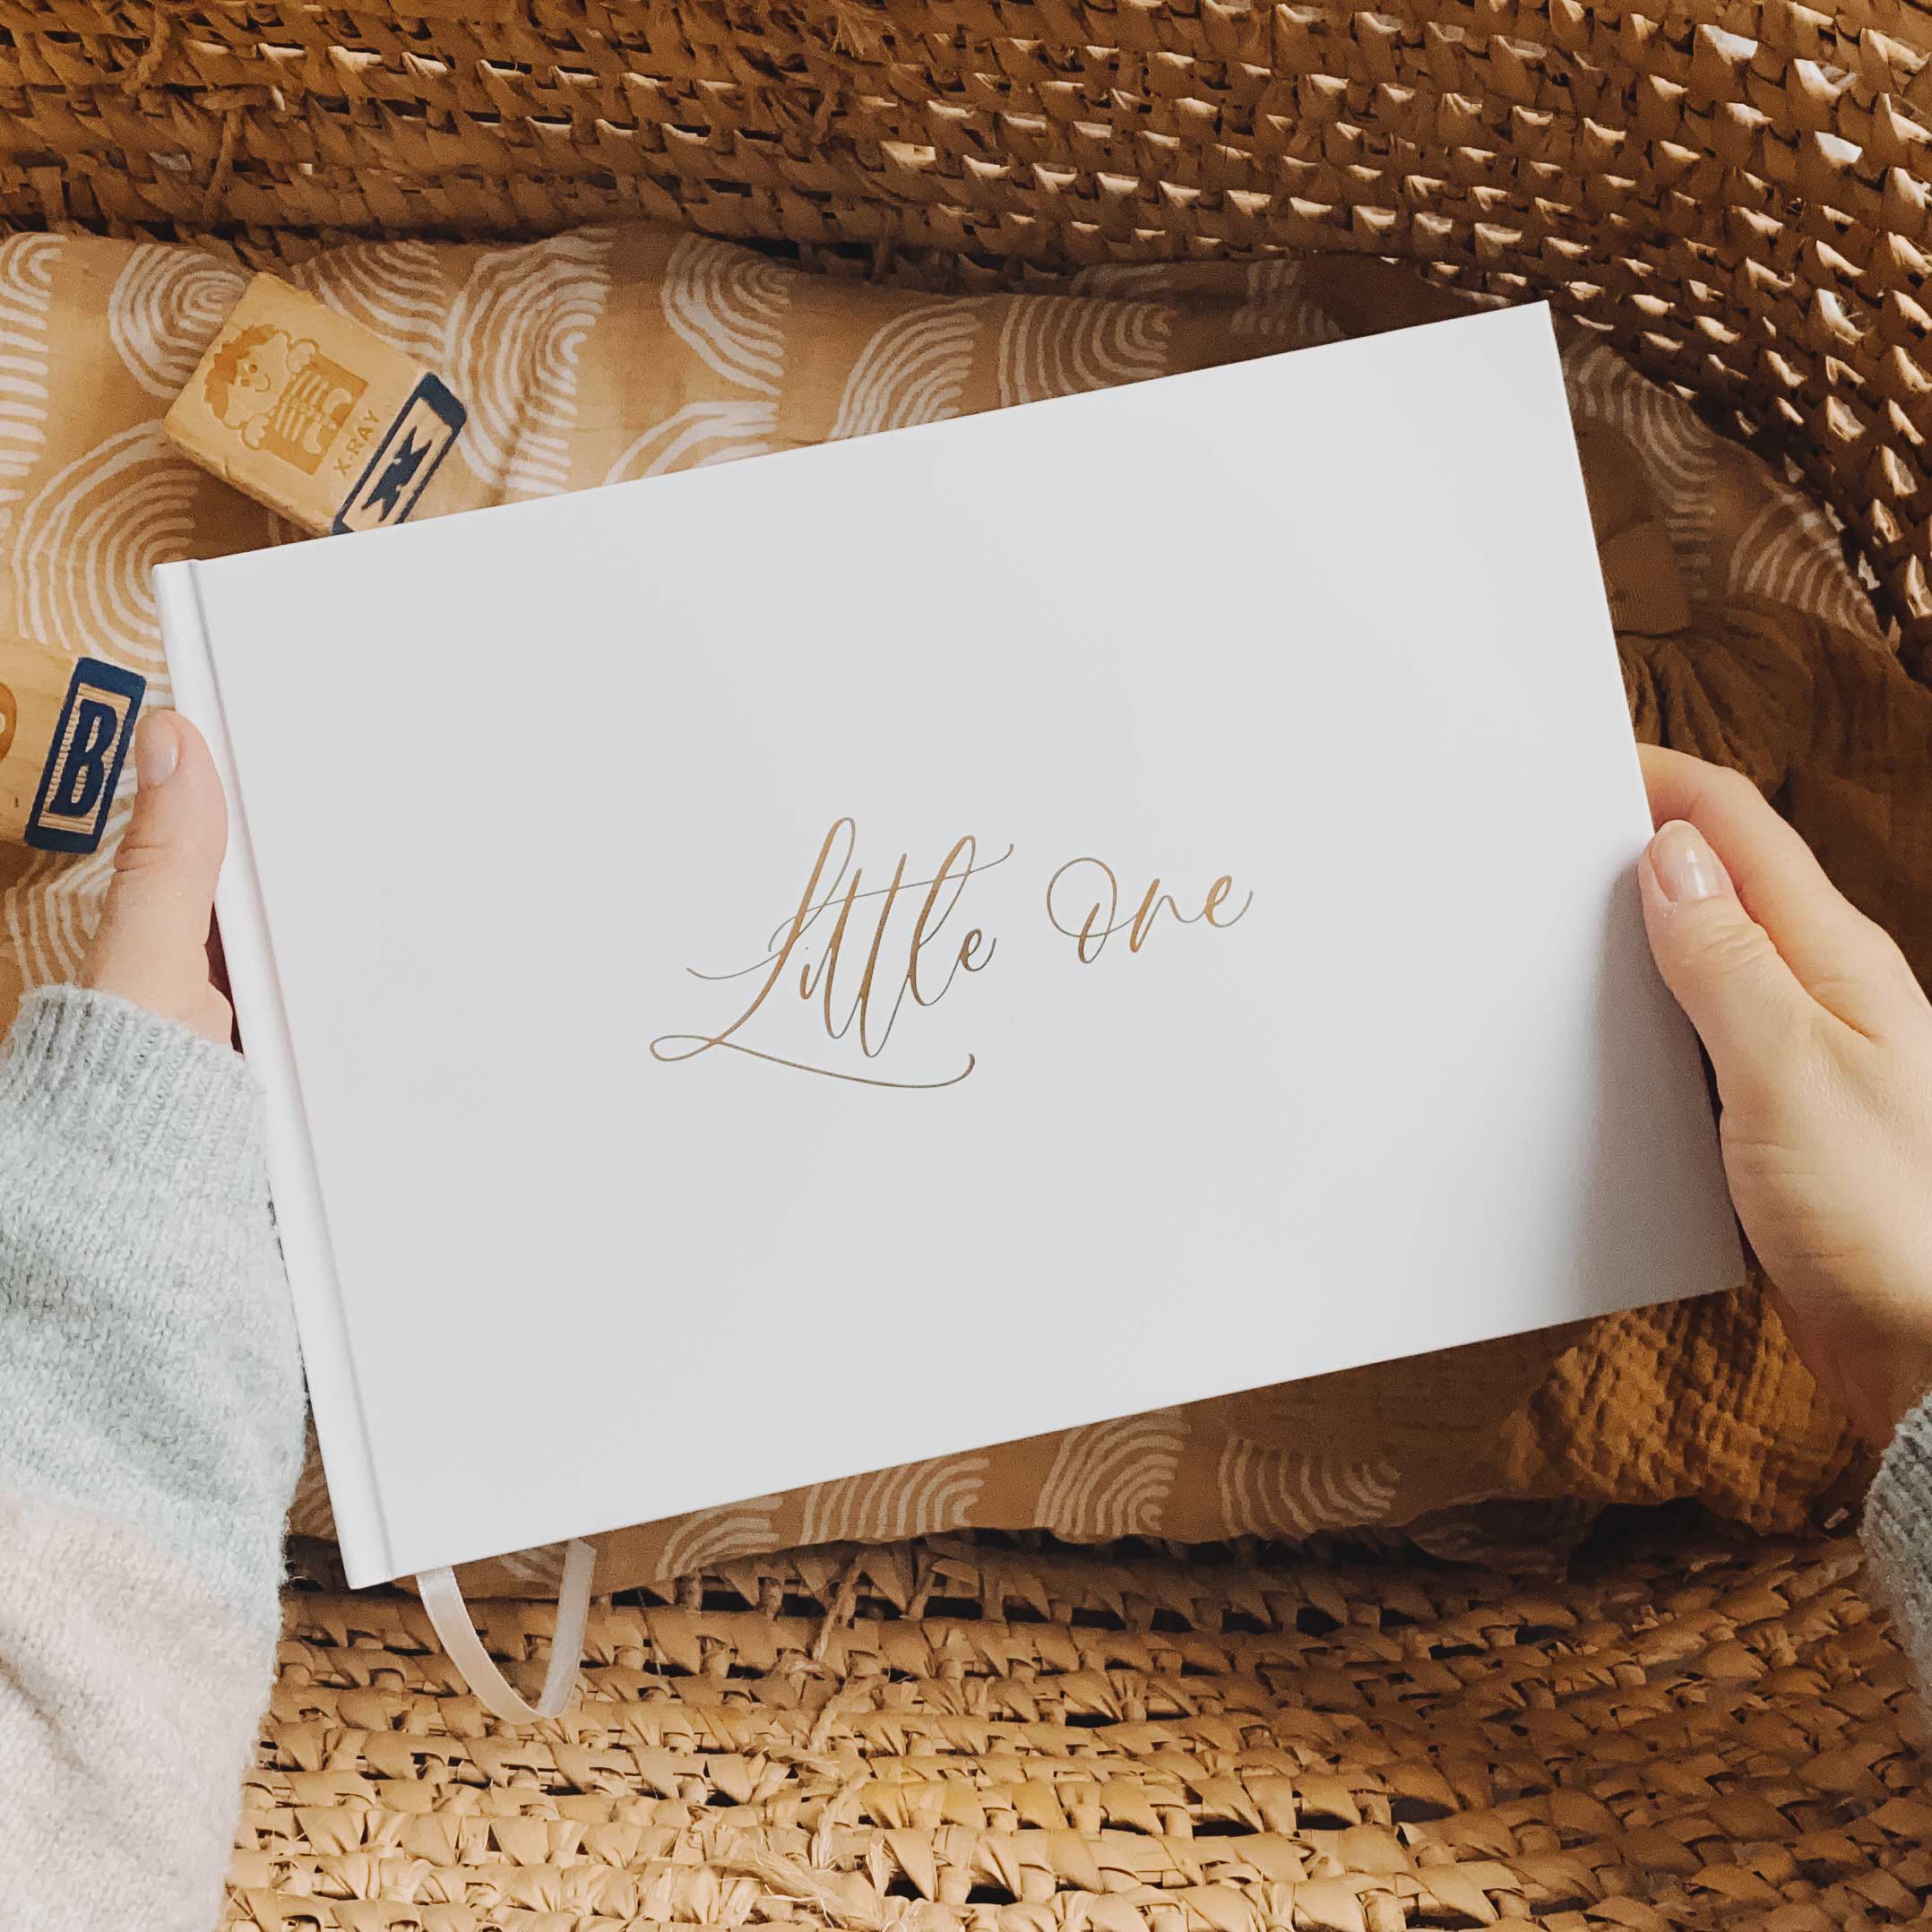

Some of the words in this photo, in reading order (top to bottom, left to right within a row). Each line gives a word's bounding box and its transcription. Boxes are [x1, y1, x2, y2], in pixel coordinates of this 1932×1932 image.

[332, 409, 382, 478] X-RAY
[48, 698, 118, 818] B
[649, 816, 1014, 1089] Little
